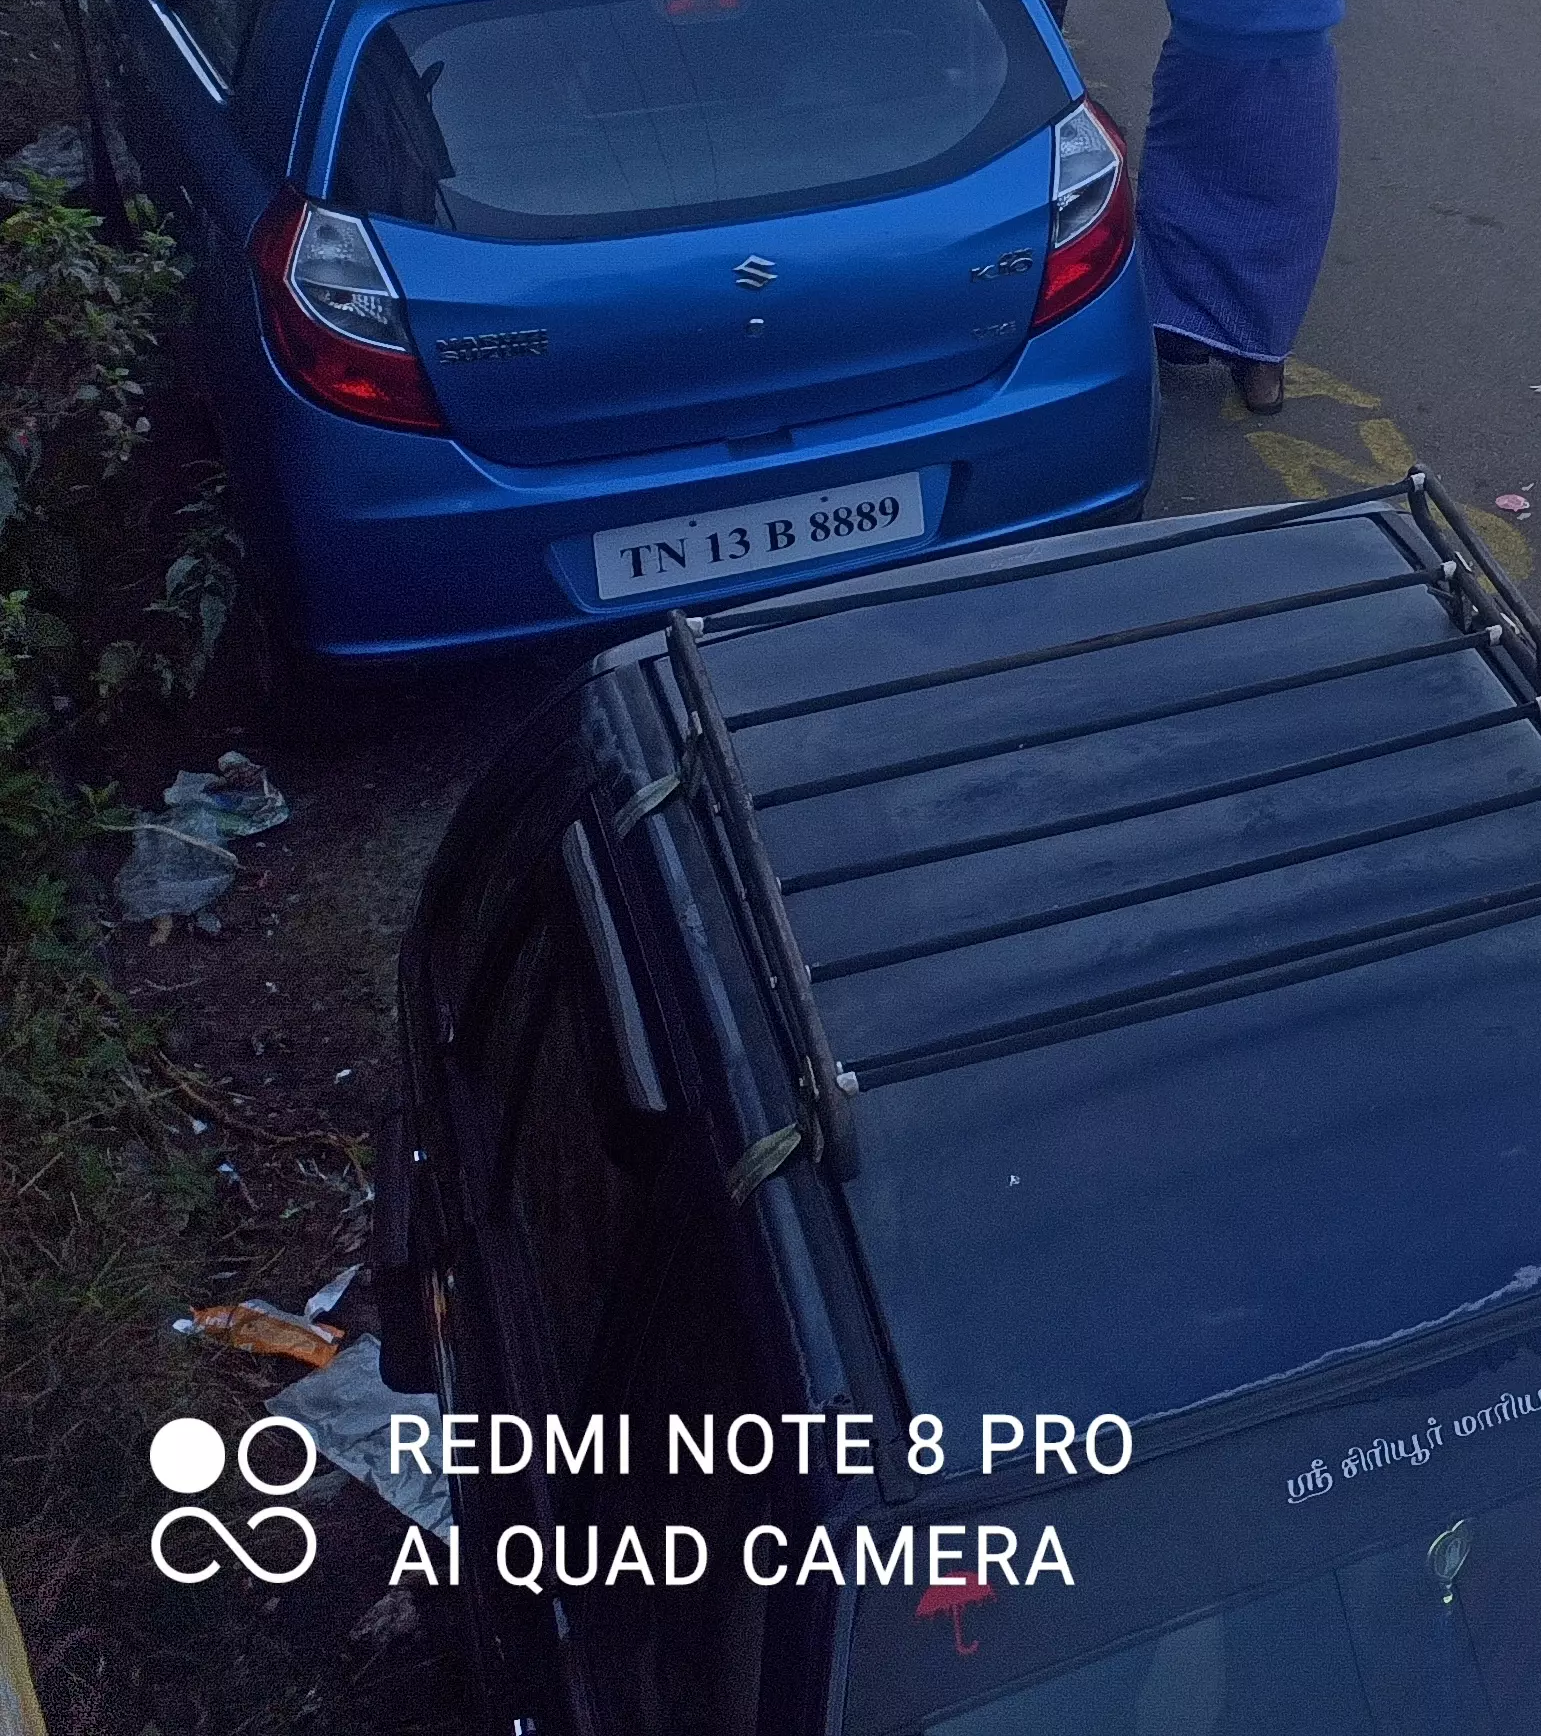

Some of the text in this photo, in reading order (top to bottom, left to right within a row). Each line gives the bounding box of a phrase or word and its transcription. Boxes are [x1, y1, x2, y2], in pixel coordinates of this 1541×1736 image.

[620, 495, 901, 579] TN 13 B 8889
